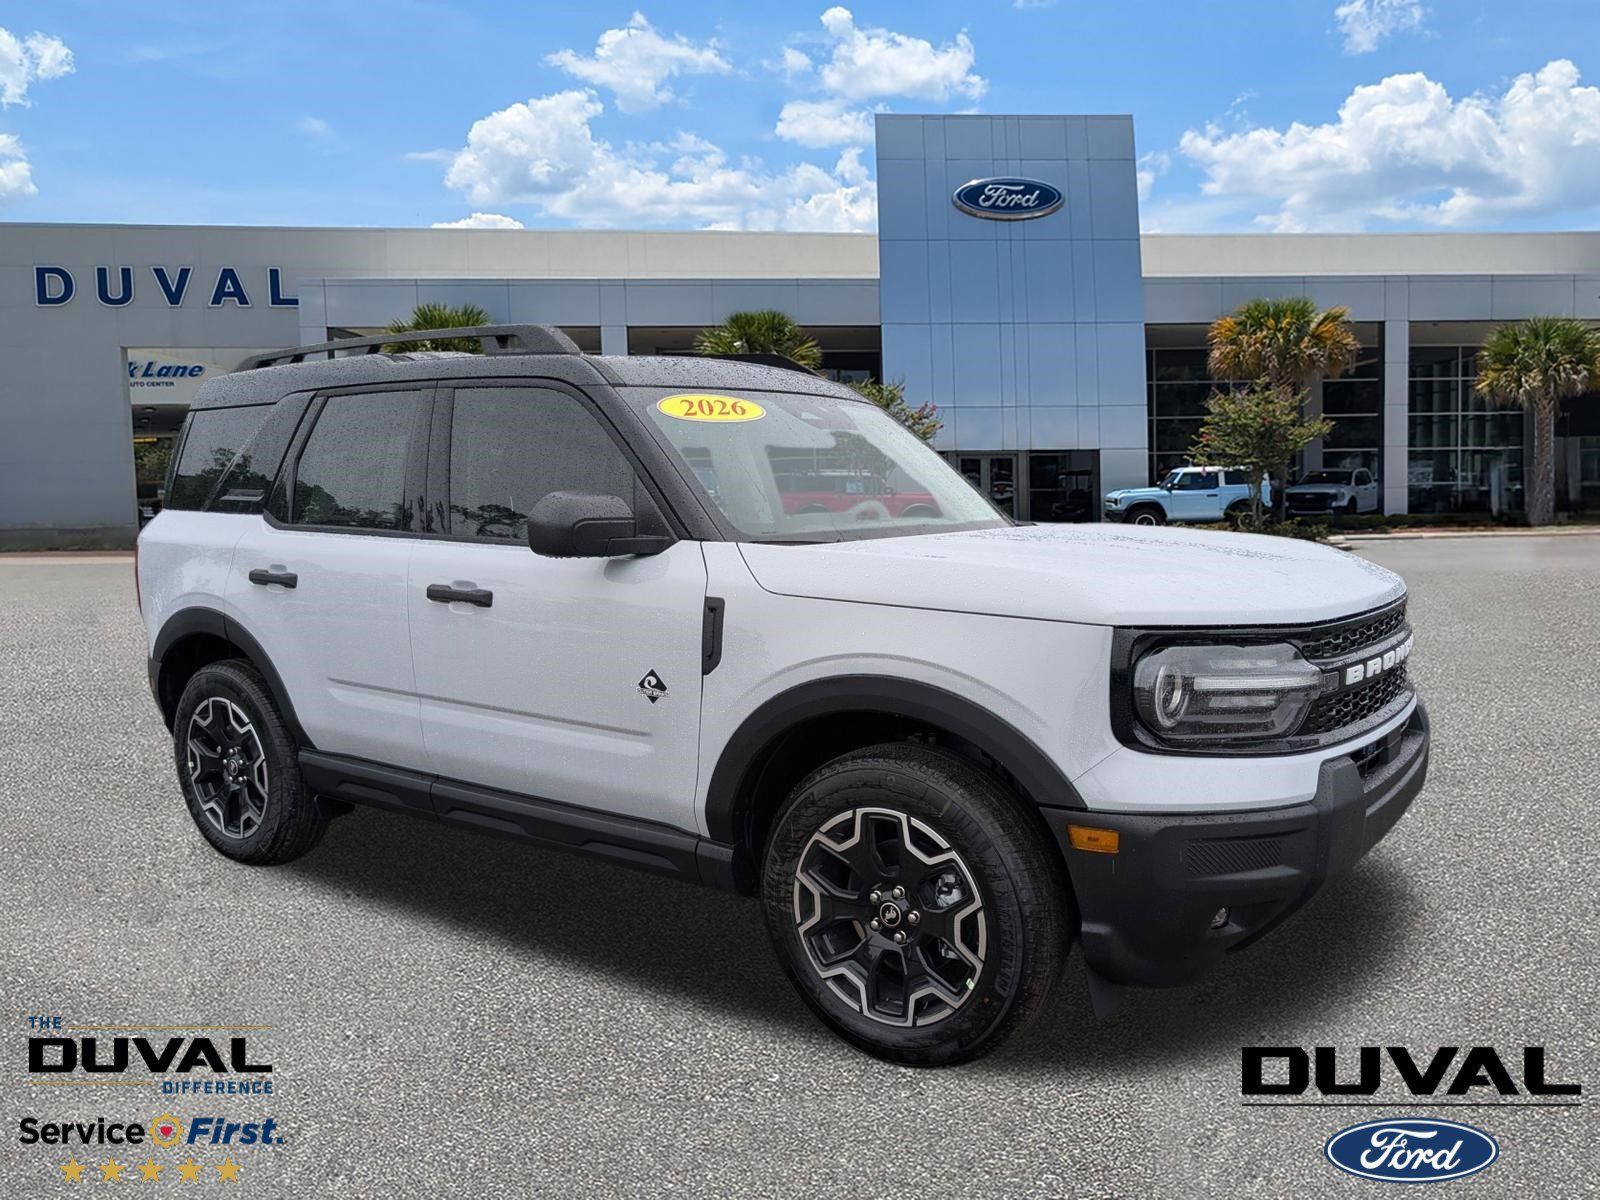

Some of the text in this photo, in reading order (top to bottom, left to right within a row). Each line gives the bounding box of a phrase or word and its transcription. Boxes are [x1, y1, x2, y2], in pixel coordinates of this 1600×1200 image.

[979, 184, 1040, 207] Ford
[33, 265, 299, 307] DUVAL
[141, 361, 205, 378] Lane
[680, 399, 746, 416] 2026
